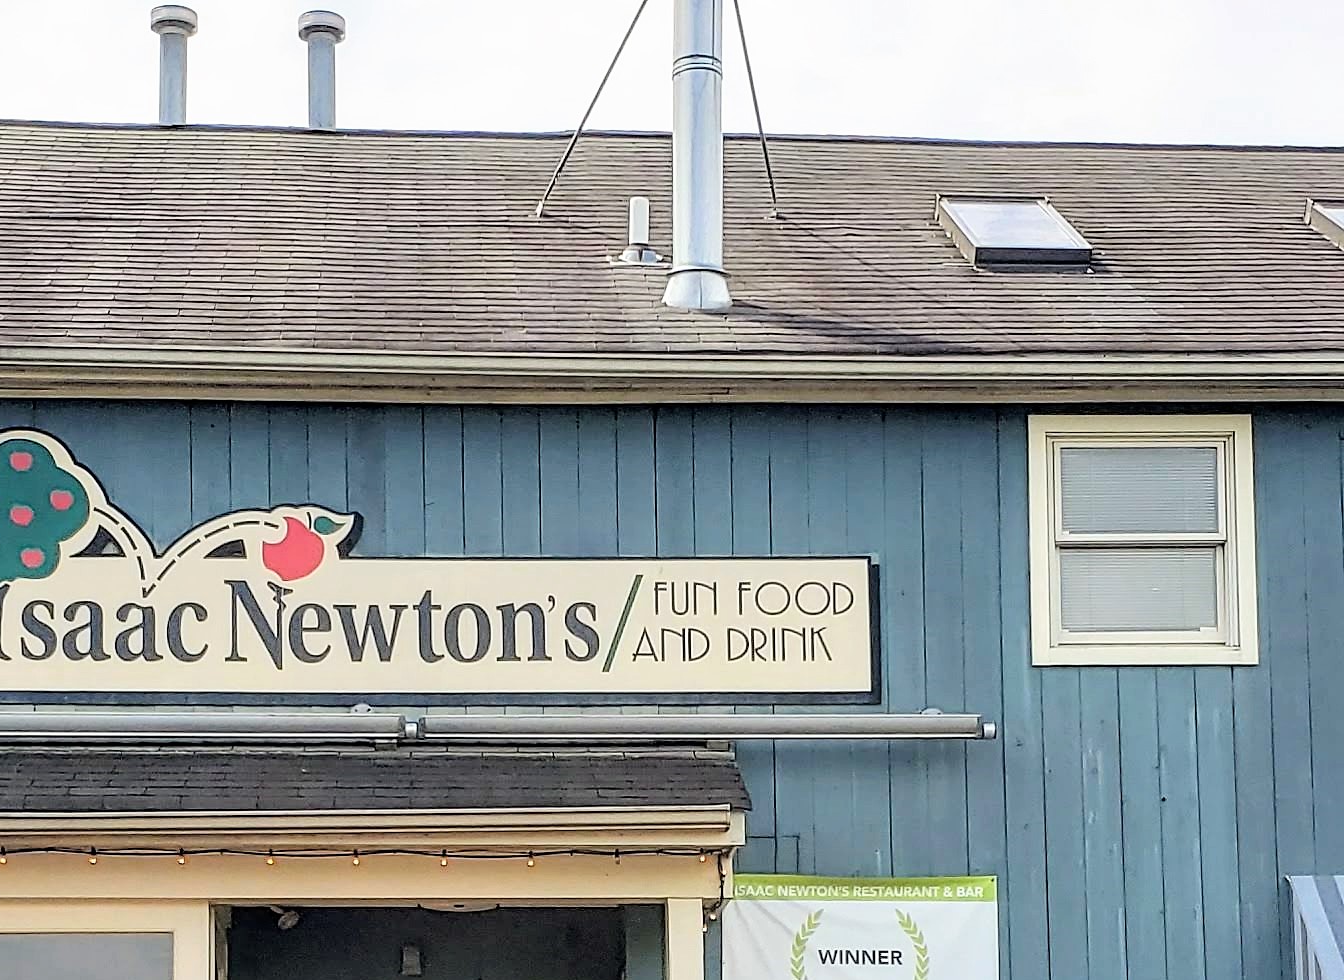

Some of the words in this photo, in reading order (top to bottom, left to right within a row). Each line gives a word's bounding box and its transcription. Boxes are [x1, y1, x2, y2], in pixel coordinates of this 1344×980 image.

[652, 579, 722, 617] FUN
[738, 579, 855, 617] FOOD
[222, 577, 600, 670] Newton's
[631, 625, 710, 665] AND
[727, 625, 834, 665] DRINK
[778, 886, 850, 897] NEWTON'S
[853, 886, 939, 898] RESTAURANT
[944, 887, 953, 898] &
[956, 887, 983, 898] BAR
[818, 949, 903, 965] WINNER
